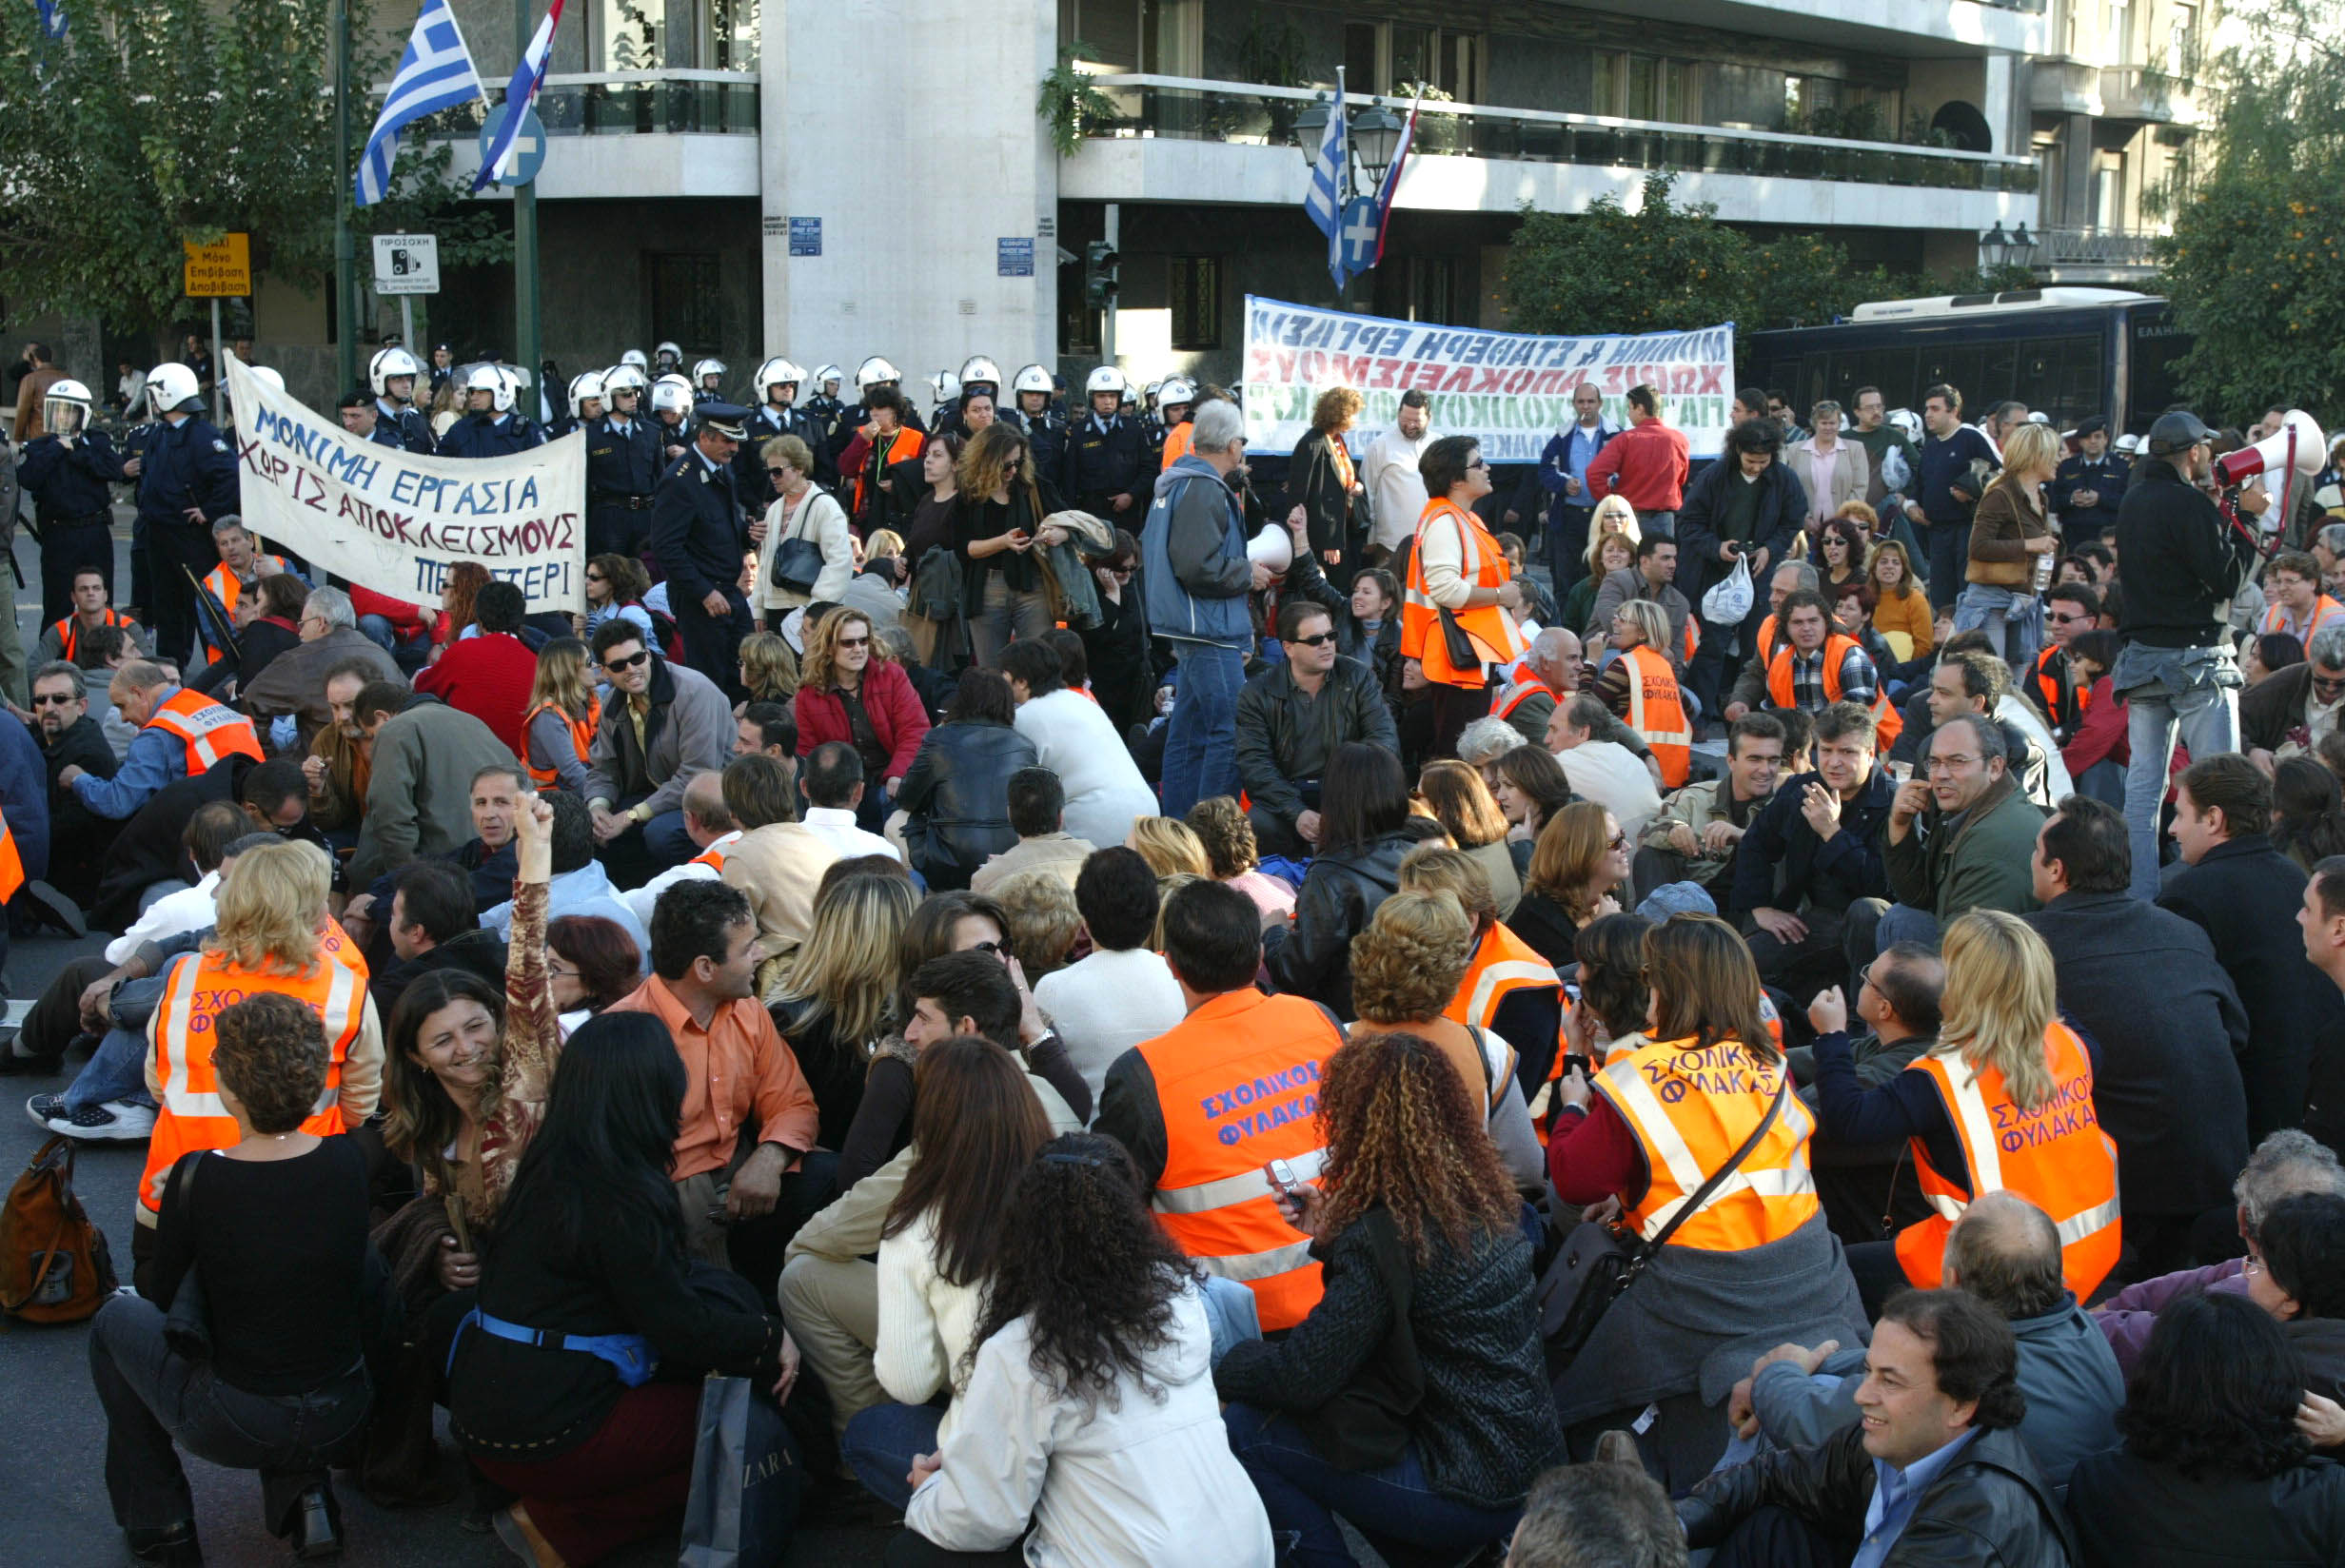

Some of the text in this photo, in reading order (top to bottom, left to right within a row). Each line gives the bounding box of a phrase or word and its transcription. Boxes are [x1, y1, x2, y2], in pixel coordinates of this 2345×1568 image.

[202, 251, 231, 263] Μόνο
[381, 238, 429, 246] ΠΡΟΣΟΧΗ
[254, 402, 540, 516] ΜΟΝΙΜΗ ΕΡΓΑΣΙΑ
[238, 435, 578, 557] ΧΩΡΙΣ ΑΠΟΚΛΕΙΣΜΟΥΣ
[1200, 1060, 1321, 1120] ΣΧΟΛΙΚΟΣ
[1660, 1068, 1777, 1104] ΦΥΛΑΚΑΣ
[743, 1447, 793, 1489] ZARA
